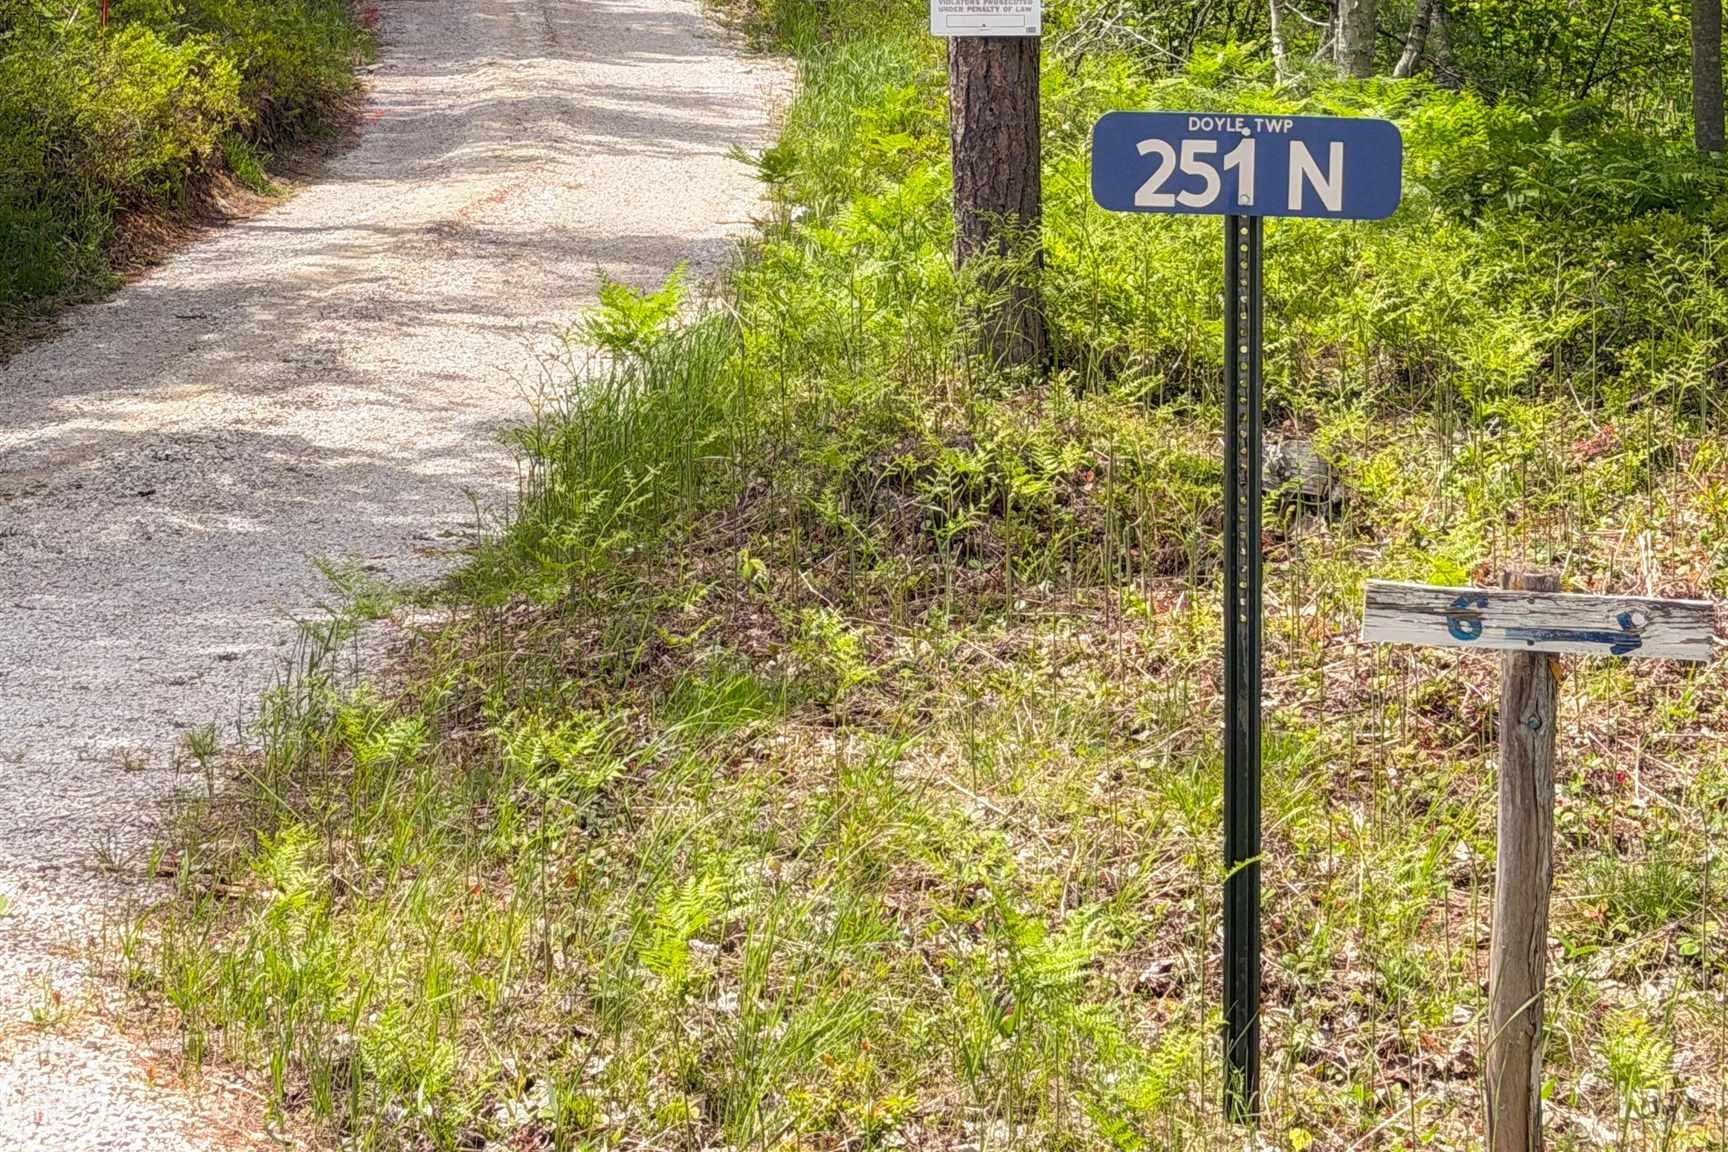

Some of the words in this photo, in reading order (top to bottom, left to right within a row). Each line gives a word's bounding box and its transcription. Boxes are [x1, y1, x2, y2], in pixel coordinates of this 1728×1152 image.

[1188, 117, 1244, 132] DOYLE
[1254, 119, 1293, 133] TWP
[1134, 138, 1255, 208] 251
[1287, 140, 1344, 211] N
